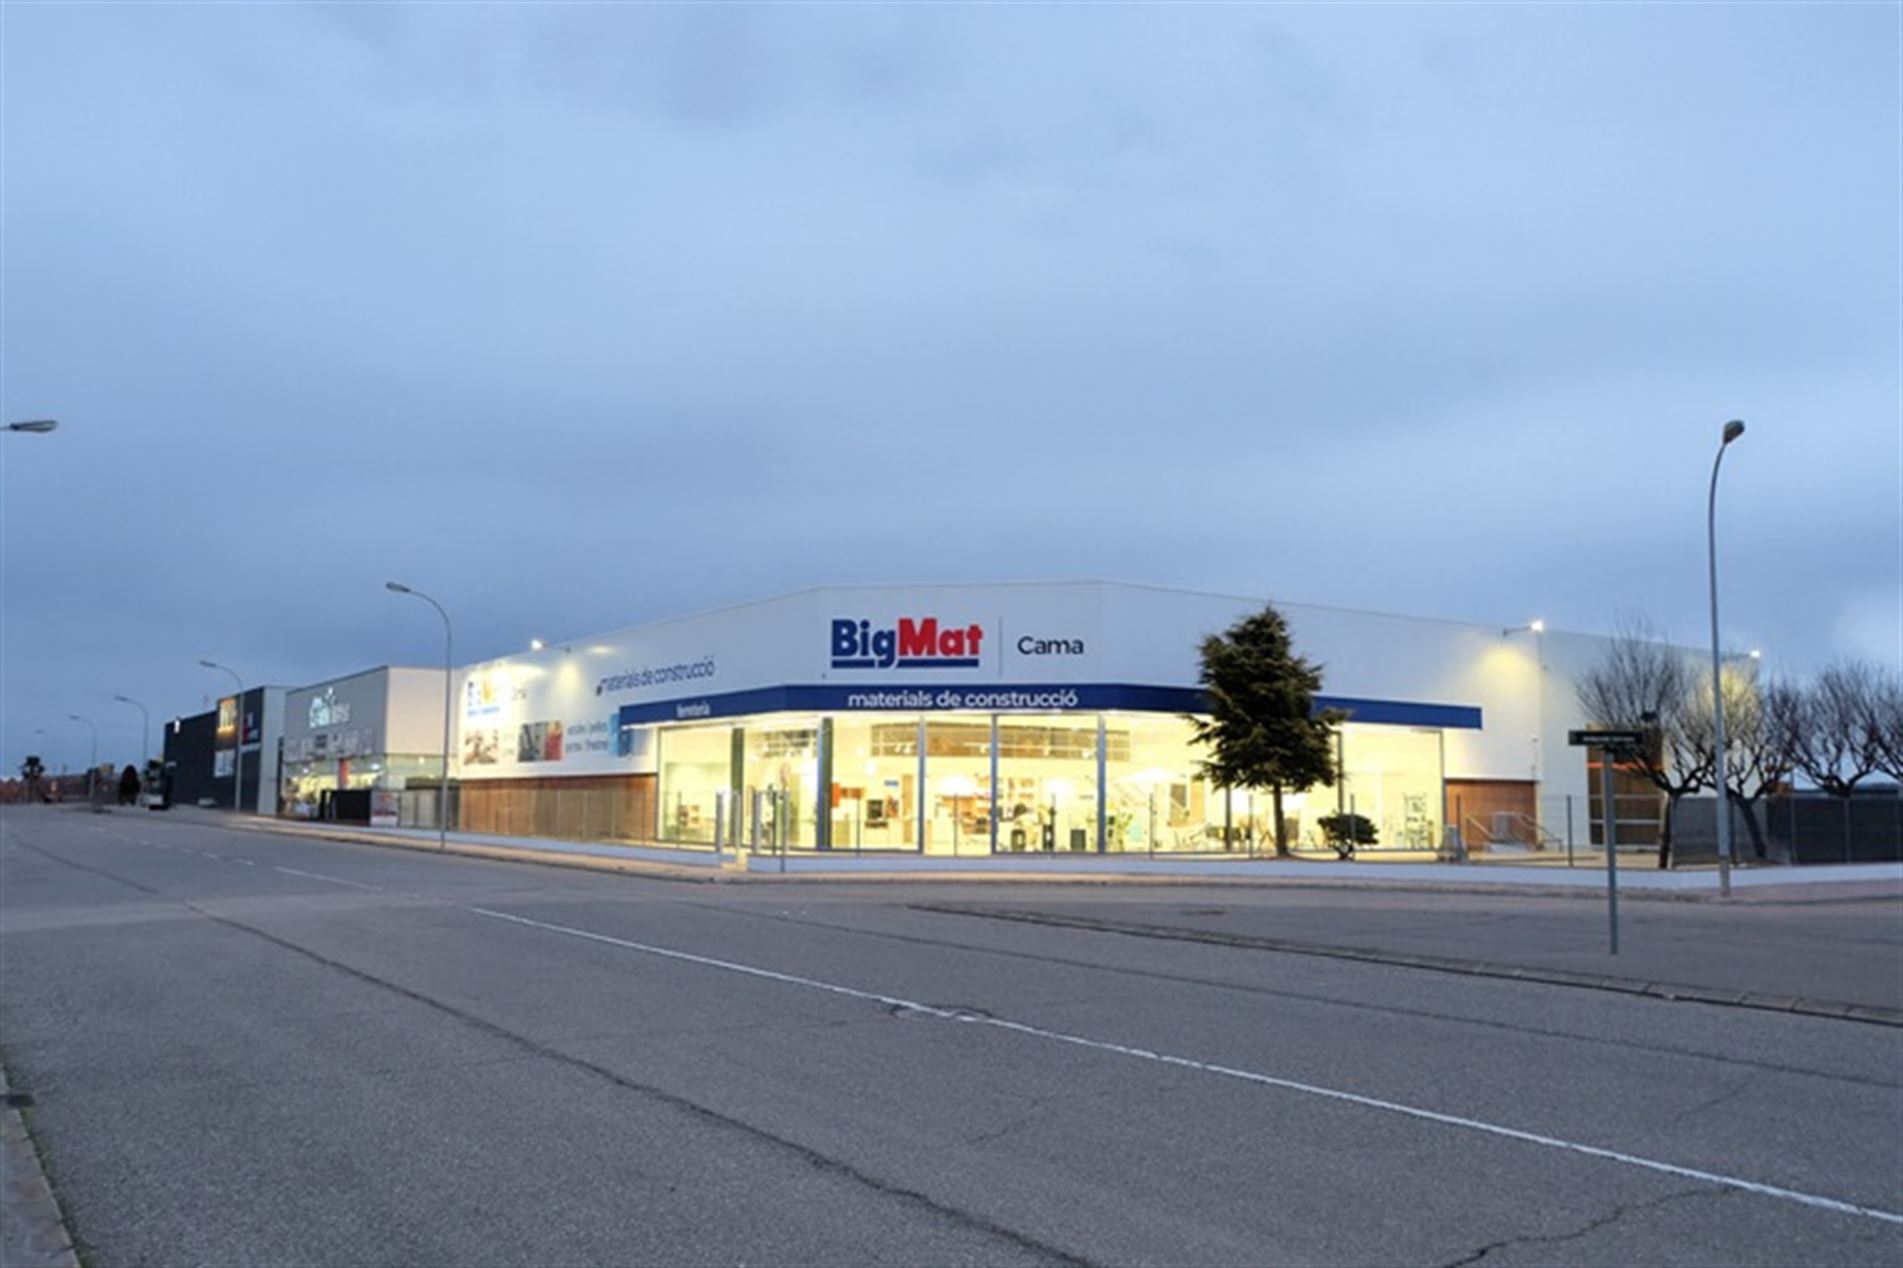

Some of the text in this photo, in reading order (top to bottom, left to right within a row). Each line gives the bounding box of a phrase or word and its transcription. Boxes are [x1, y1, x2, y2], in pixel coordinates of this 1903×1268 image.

[831, 617, 983, 669] BigMat
[1017, 635, 1084, 656] Cama
[848, 689, 1078, 708] materials de construcció
